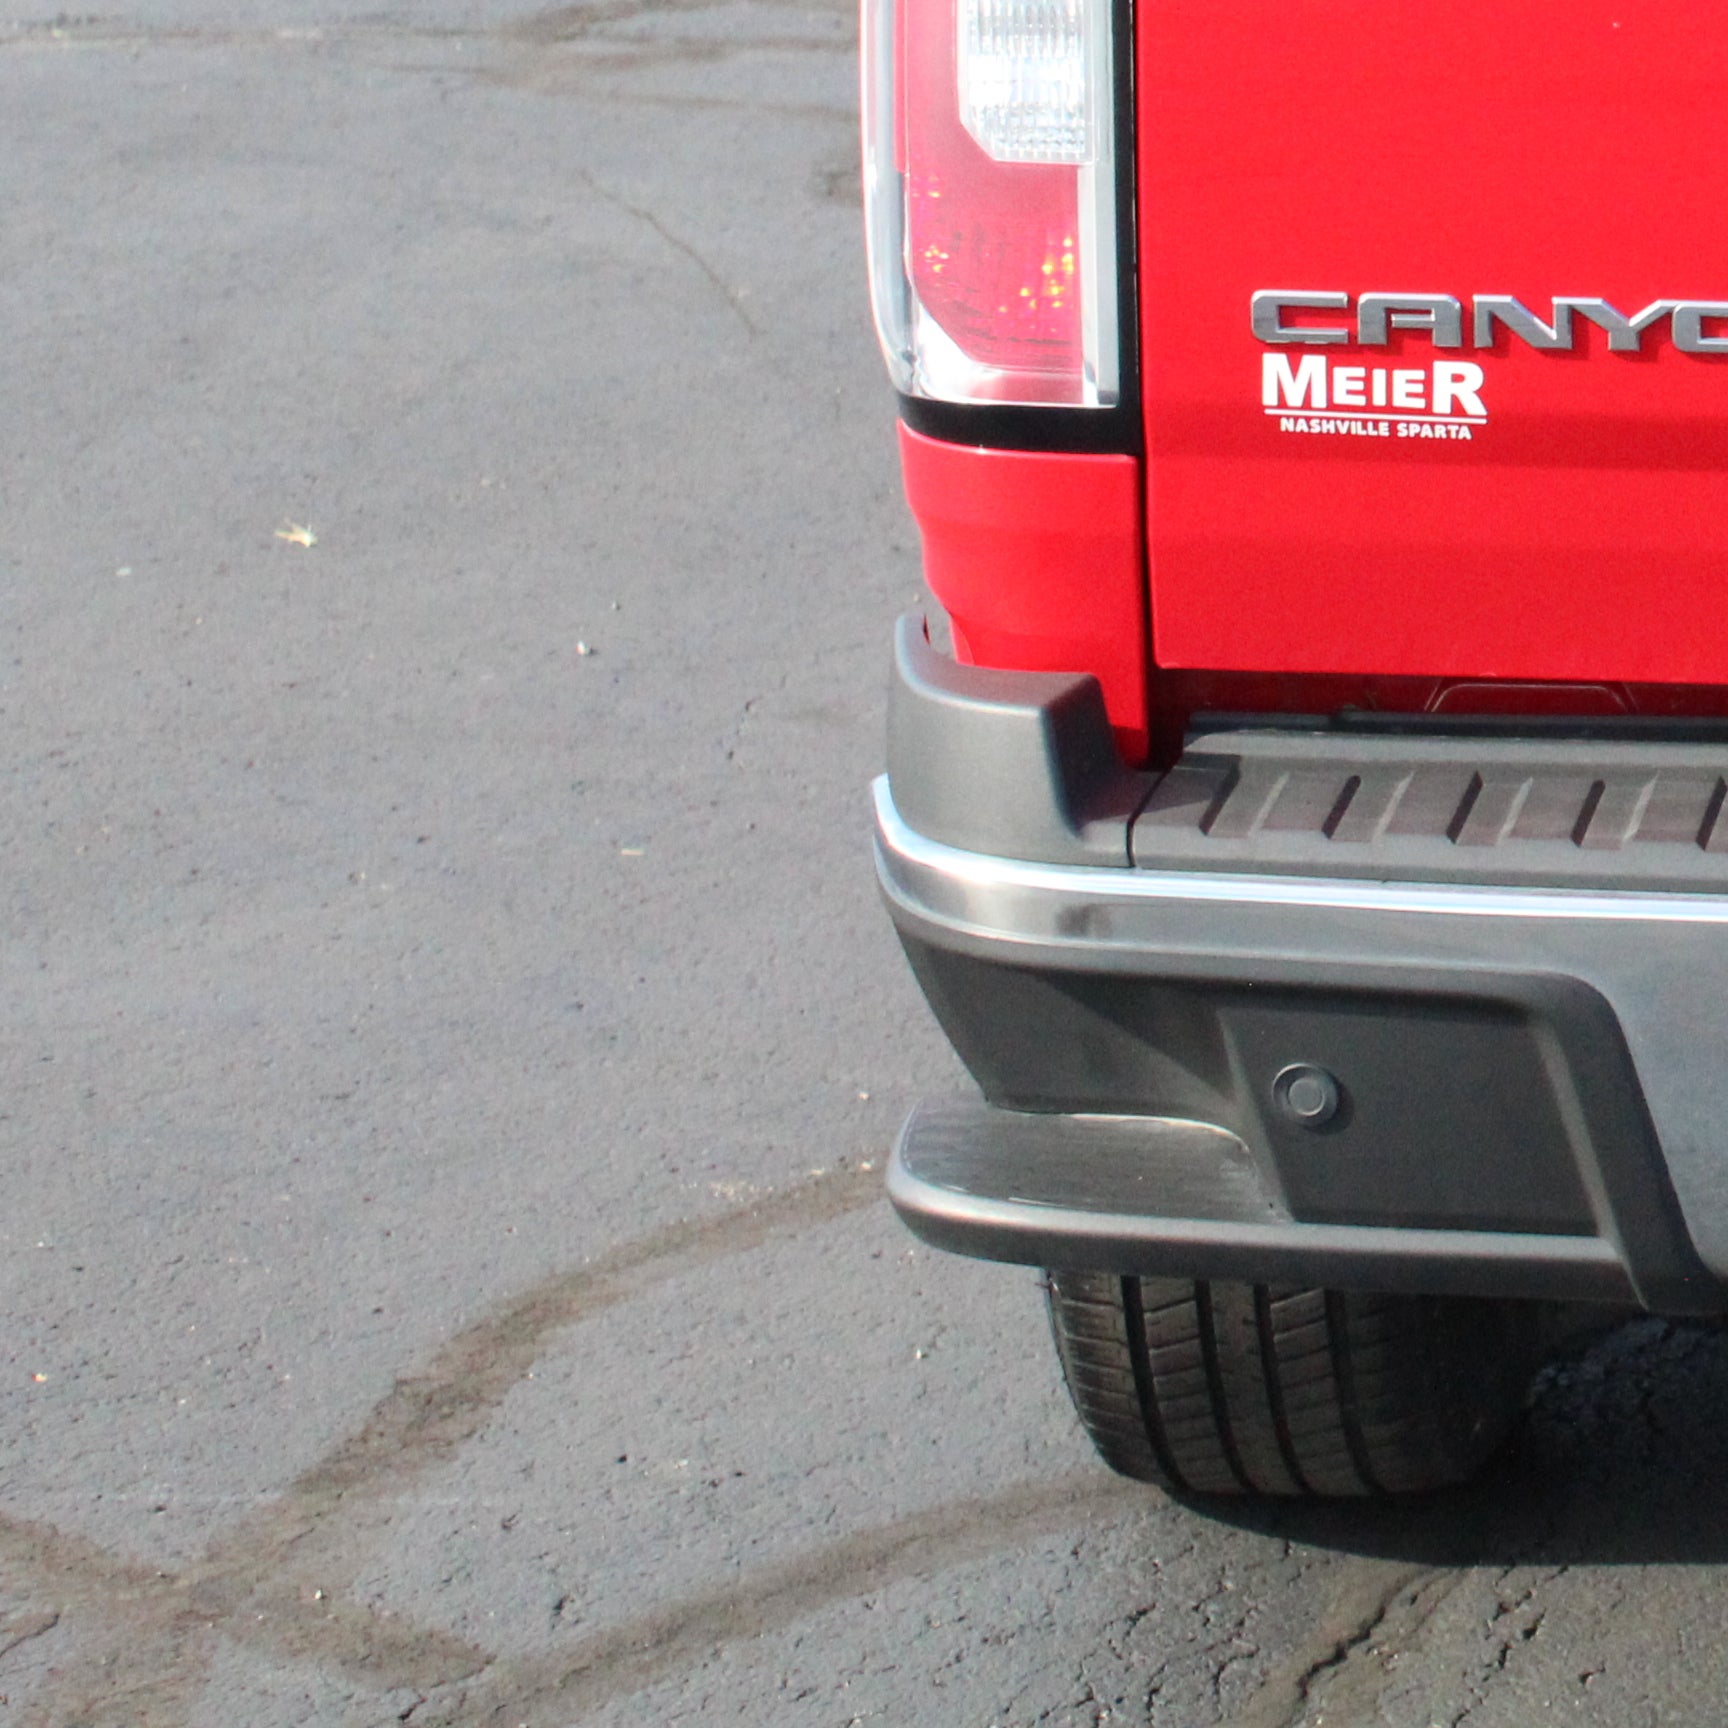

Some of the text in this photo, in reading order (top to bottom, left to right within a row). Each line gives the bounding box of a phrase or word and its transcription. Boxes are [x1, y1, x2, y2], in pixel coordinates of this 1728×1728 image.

[1261, 352, 1488, 416] MEIER
[1279, 416, 1473, 440] NASHVILLE SPARTA
